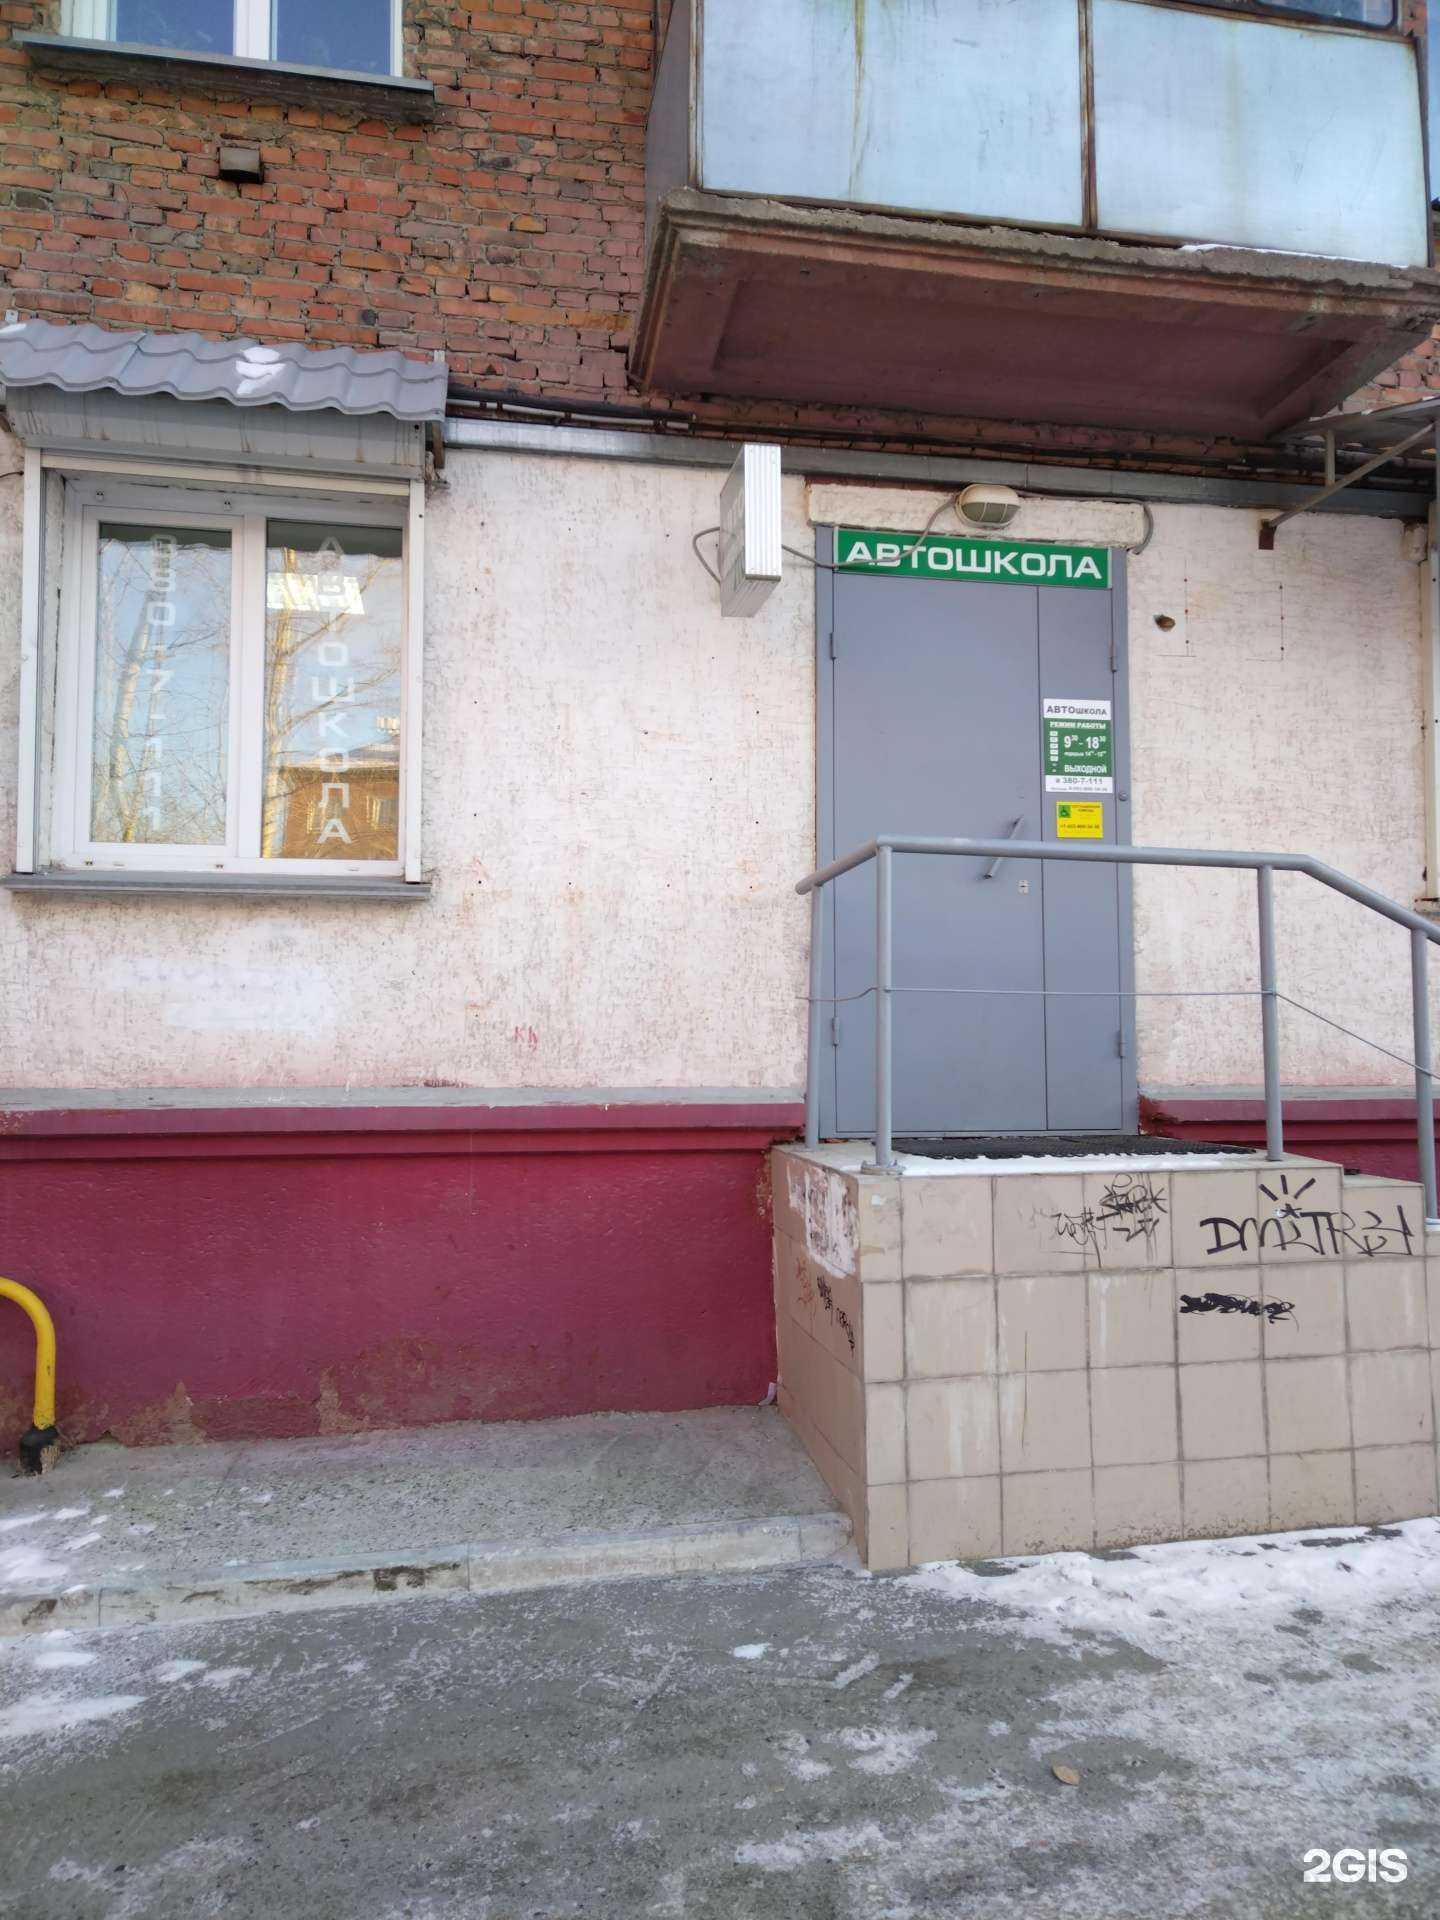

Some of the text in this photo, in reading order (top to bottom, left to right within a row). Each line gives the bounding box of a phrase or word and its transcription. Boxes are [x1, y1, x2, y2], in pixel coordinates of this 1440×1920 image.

[845, 541, 1102, 579] АВТОШКОЛА
[1049, 721, 1106, 730] РЕЖИМ РАБОТЫ
[1064, 764, 1107, 774] ВЫХОДНОЙ
